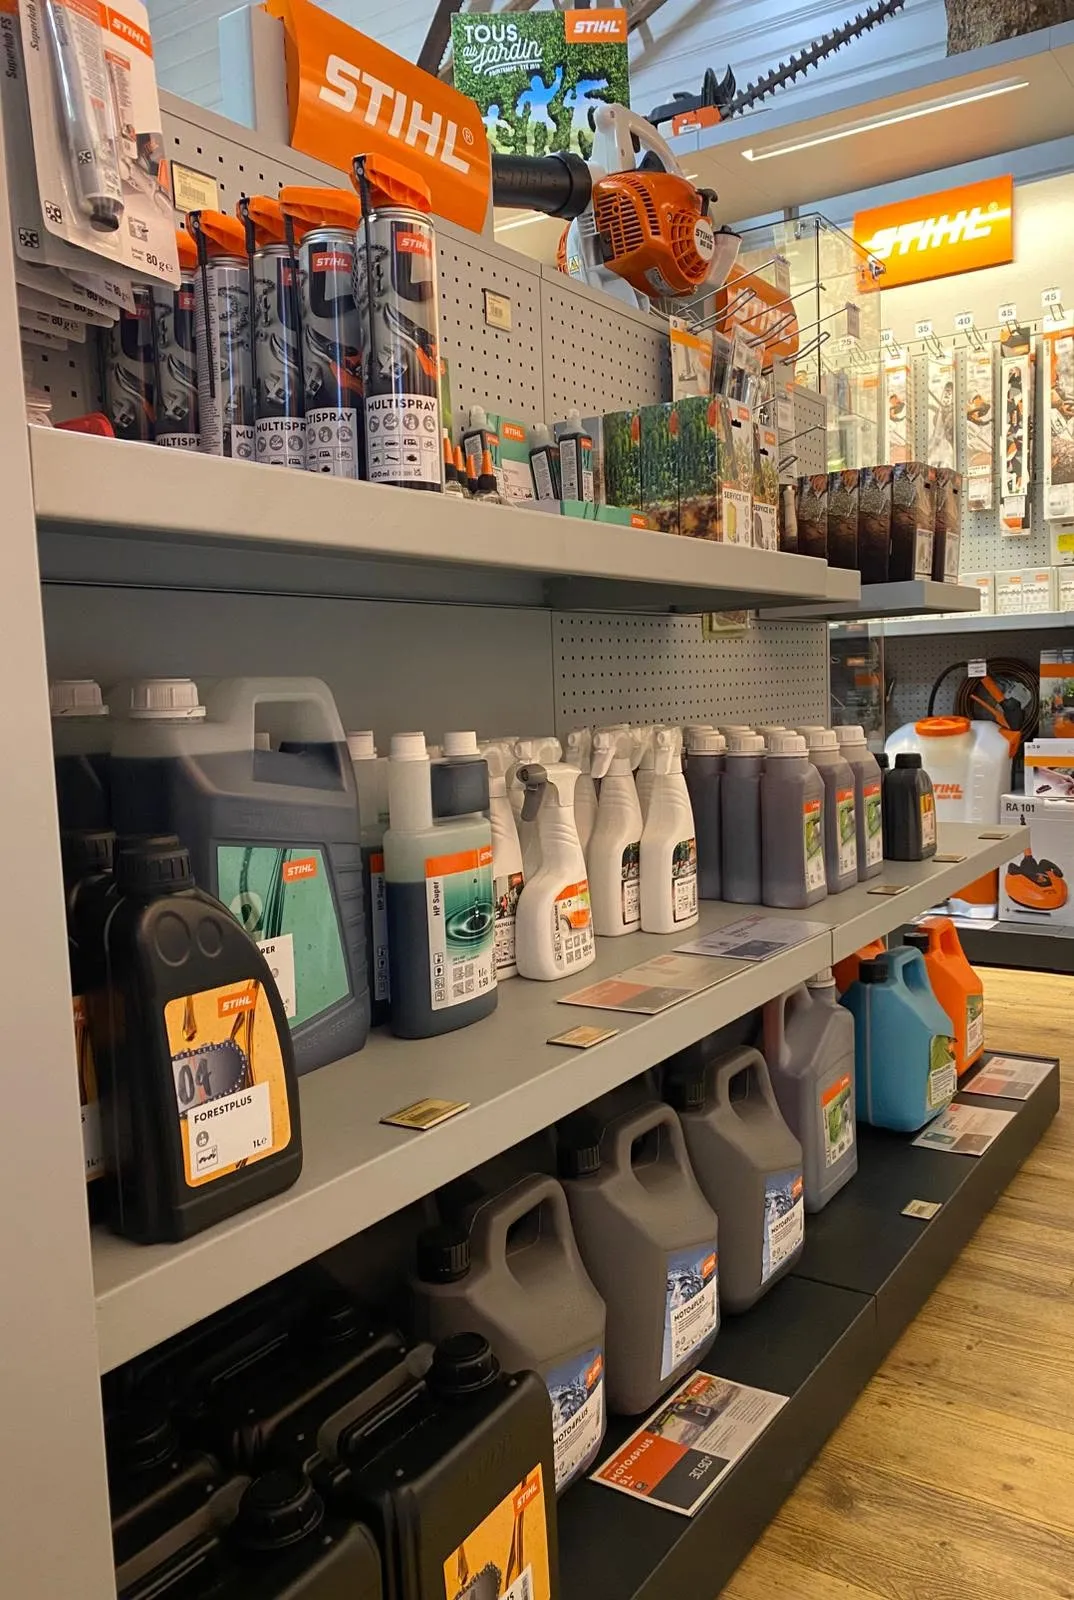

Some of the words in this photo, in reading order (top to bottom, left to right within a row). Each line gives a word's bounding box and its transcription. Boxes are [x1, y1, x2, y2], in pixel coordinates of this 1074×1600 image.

[111, 17, 148, 48] STIHL
[463, 24, 518, 44] TOUS
[573, 20, 620, 34] STIHL
[4, 31, 17, 80] Superlub
[462, 45, 479, 57] au
[473, 37, 543, 74] jardin
[399, 237, 430, 252] STIHL
[146, 253, 157, 266] 80
[315, 256, 348, 267] STIHL
[1001, 309, 1013, 317] 45
[957, 316, 971, 326] 40
[918, 325, 930, 333] 35
[367, 398, 436, 412] MULTISPRAY
[503, 426, 523, 439] STIHL
[724, 491, 742, 502] SERVICE
[753, 503, 768, 513] SERVICE
[1006, 803, 1019, 812] RA
[1021, 804, 1035, 813] 101
[286, 863, 314, 877] STIHL
[433, 906, 440, 917] HP
[222, 996, 253, 1011] STIHL
[194, 1095, 253, 1124] FORESTPLUS
[674, 1294, 705, 1322] MOTO4PLUS
[553, 1407, 589, 1446] MOTO4PLUS
[610, 1438, 654, 1482] MOTO4PLUS
[516, 1484, 538, 1510] STIHL
